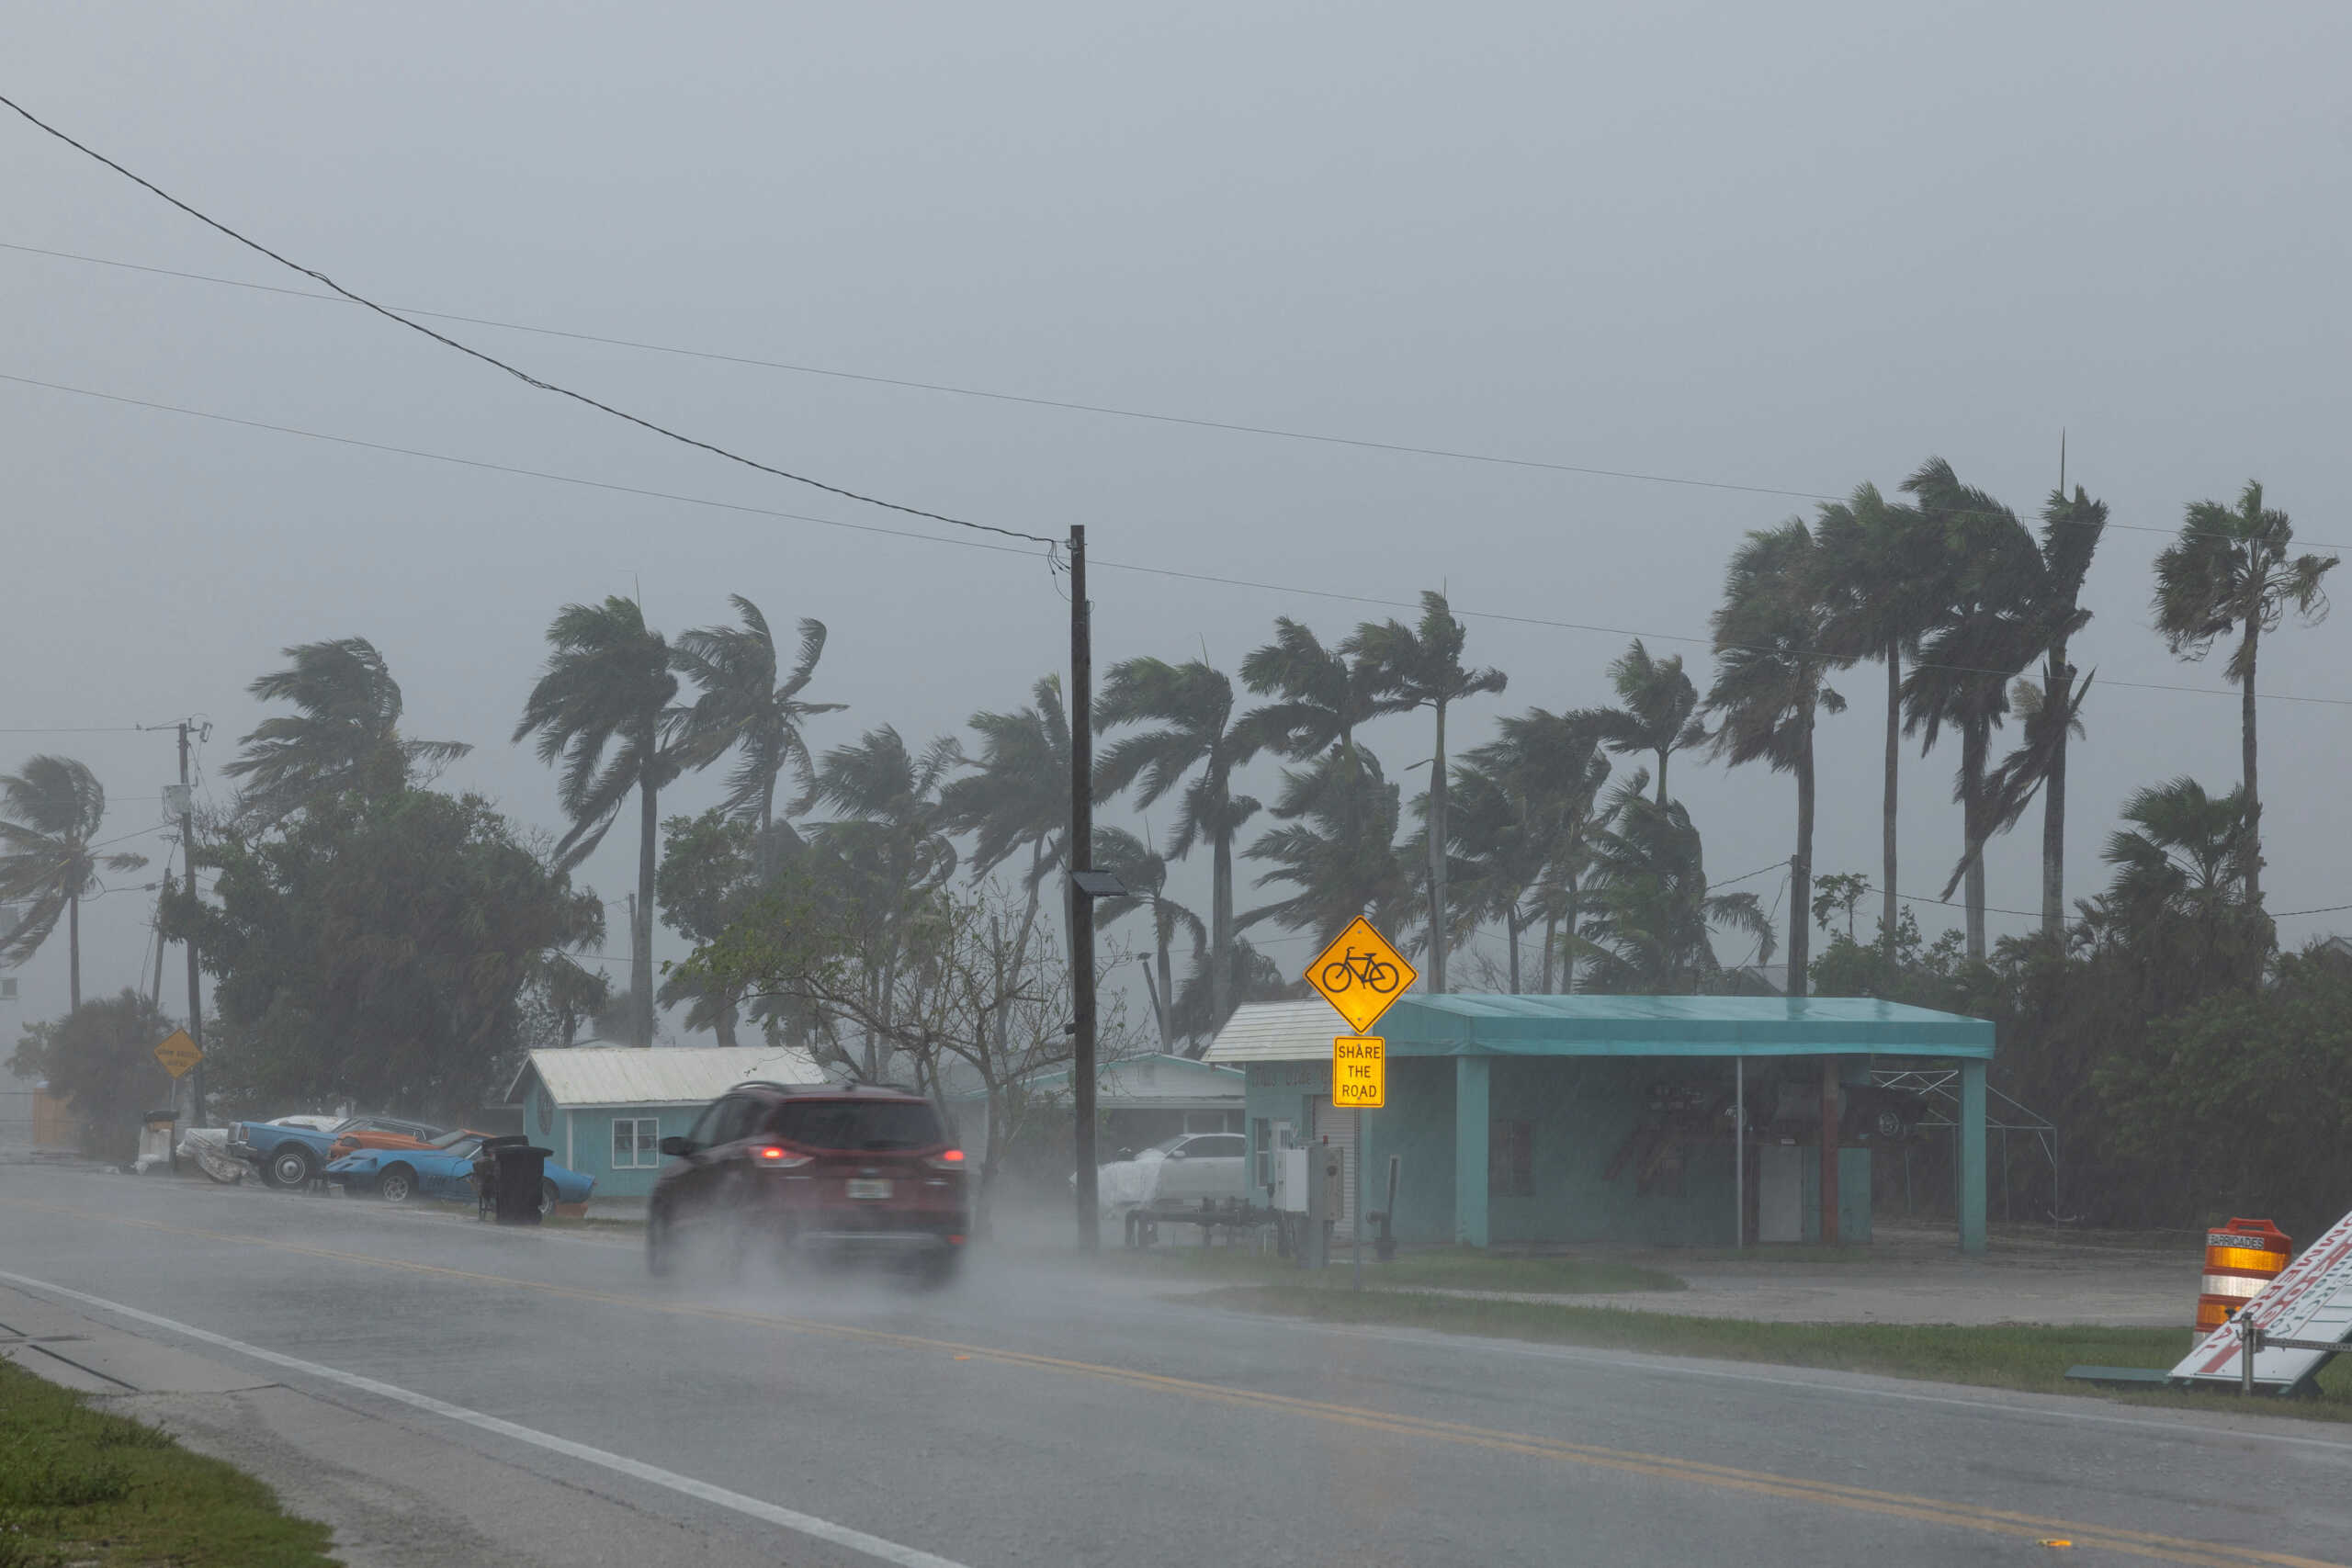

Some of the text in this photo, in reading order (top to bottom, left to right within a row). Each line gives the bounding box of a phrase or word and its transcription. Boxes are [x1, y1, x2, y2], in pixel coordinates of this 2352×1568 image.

[1339, 1045, 1380, 1058] SHARE
[1348, 1066, 1371, 1077] THE
[1342, 1085, 1376, 1097] ROAD
